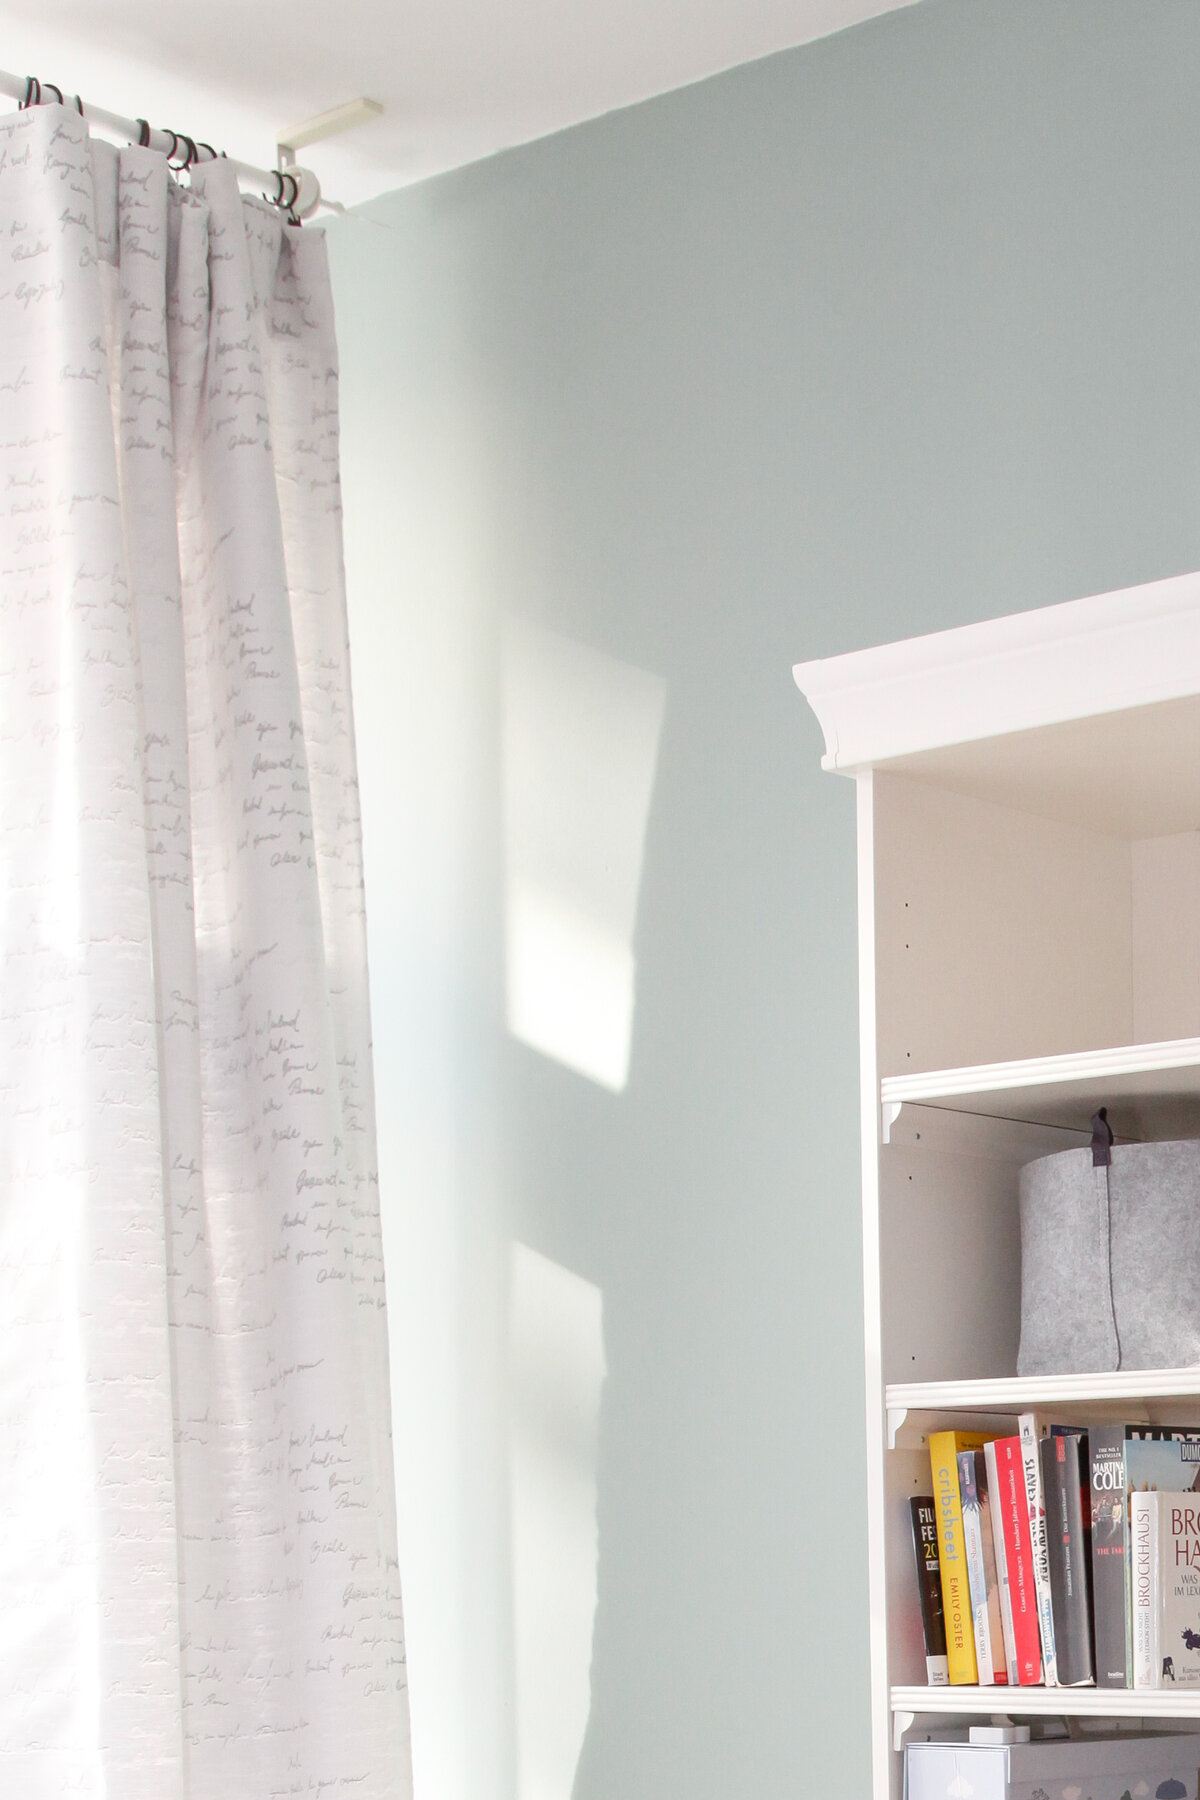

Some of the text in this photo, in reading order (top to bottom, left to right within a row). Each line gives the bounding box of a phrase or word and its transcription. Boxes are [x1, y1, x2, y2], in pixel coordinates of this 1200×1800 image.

[1092, 1462, 1124, 1474] MARTINA
[1025, 1458, 1036, 1502] SLAVES
[1092, 1471, 1124, 1491] COLE
[919, 1508, 935, 1523] FIL
[938, 1468, 964, 1649] cribsheet EMILY OSTER
[1136, 1507, 1150, 1607] BROCKHAUS!
[1181, 1574, 1198, 1584] WAS
[1174, 1587, 1184, 1596] IM
